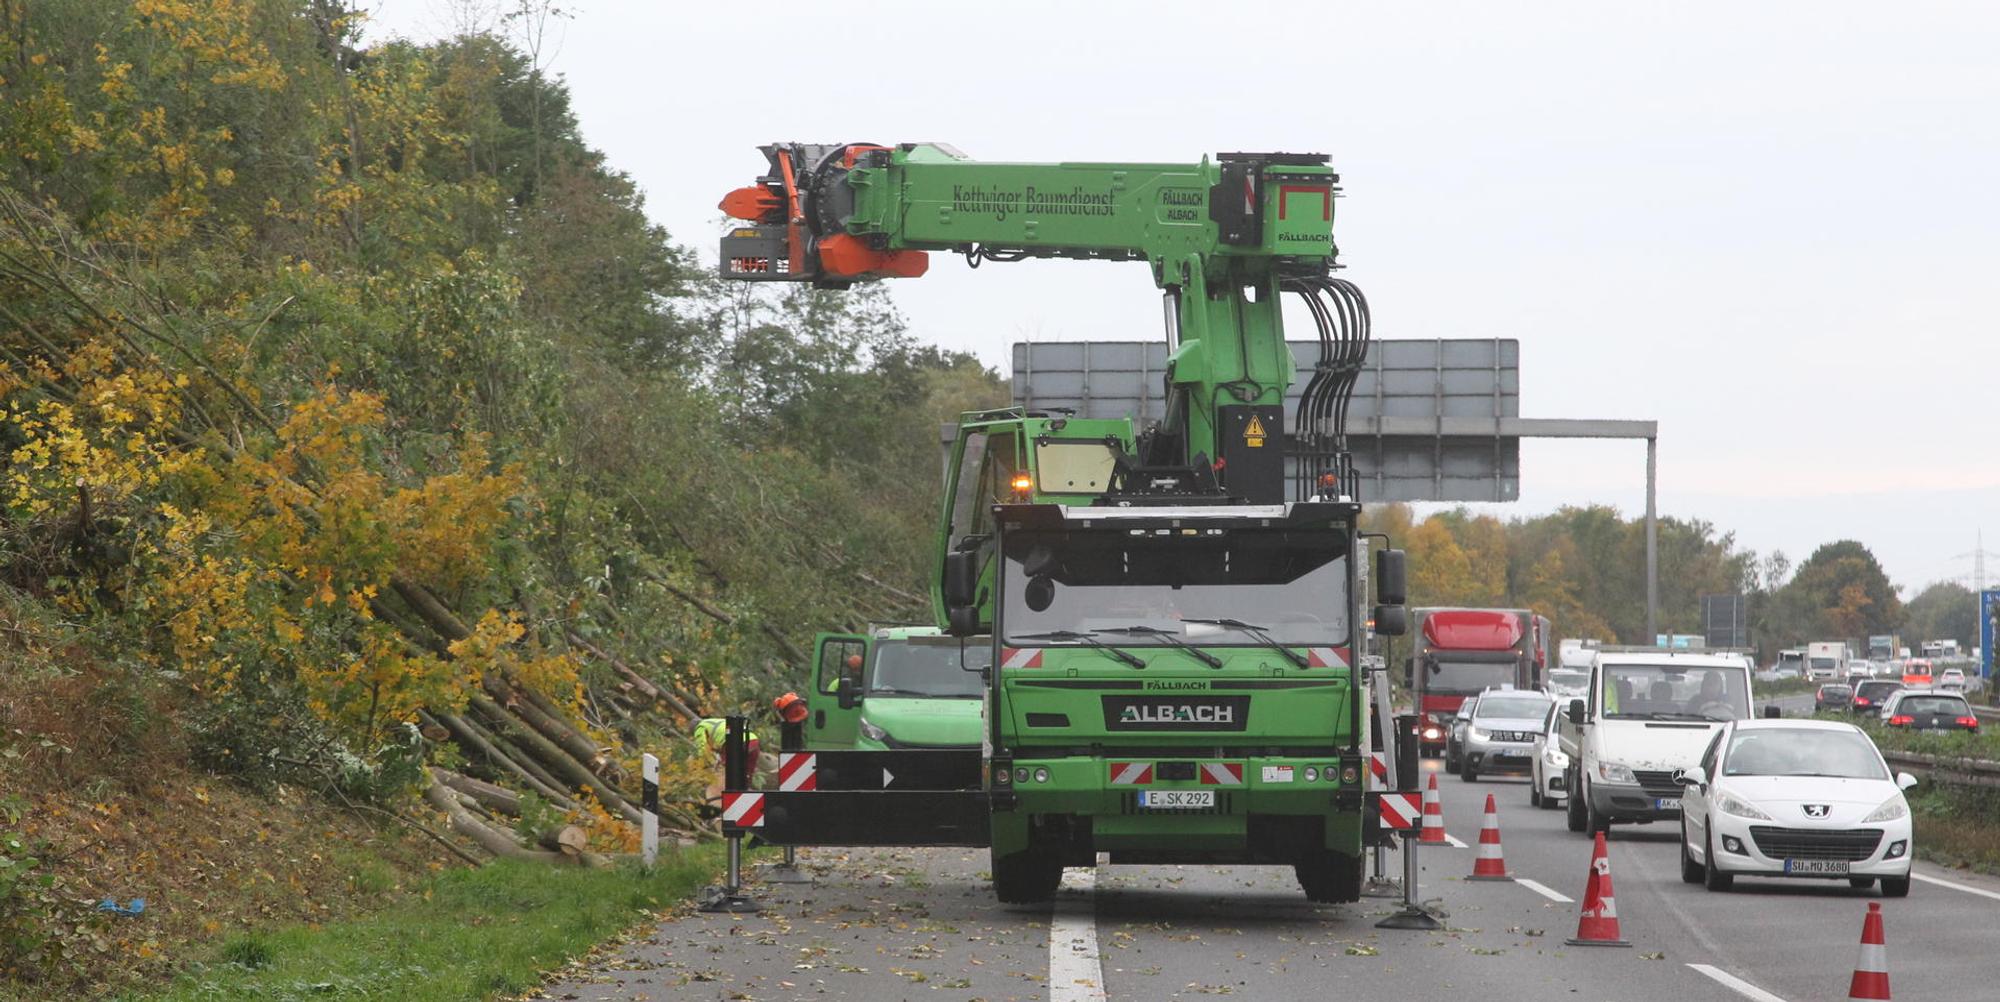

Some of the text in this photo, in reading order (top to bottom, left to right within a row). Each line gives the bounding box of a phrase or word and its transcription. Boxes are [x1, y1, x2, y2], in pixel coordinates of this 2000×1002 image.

[953, 185, 1115, 221] Kettwiger Baumdienst
[1163, 189, 1202, 205] FÄLLBACH
[1168, 209, 1198, 221] ALBACH
[1278, 233, 1329, 243] FÄLLBACH
[1147, 681, 1206, 690] FÄLLBACH
[1120, 705, 1233, 722] ALBACH
[1150, 792, 1210, 805] E SK 292
[1792, 861, 1804, 871] SU
